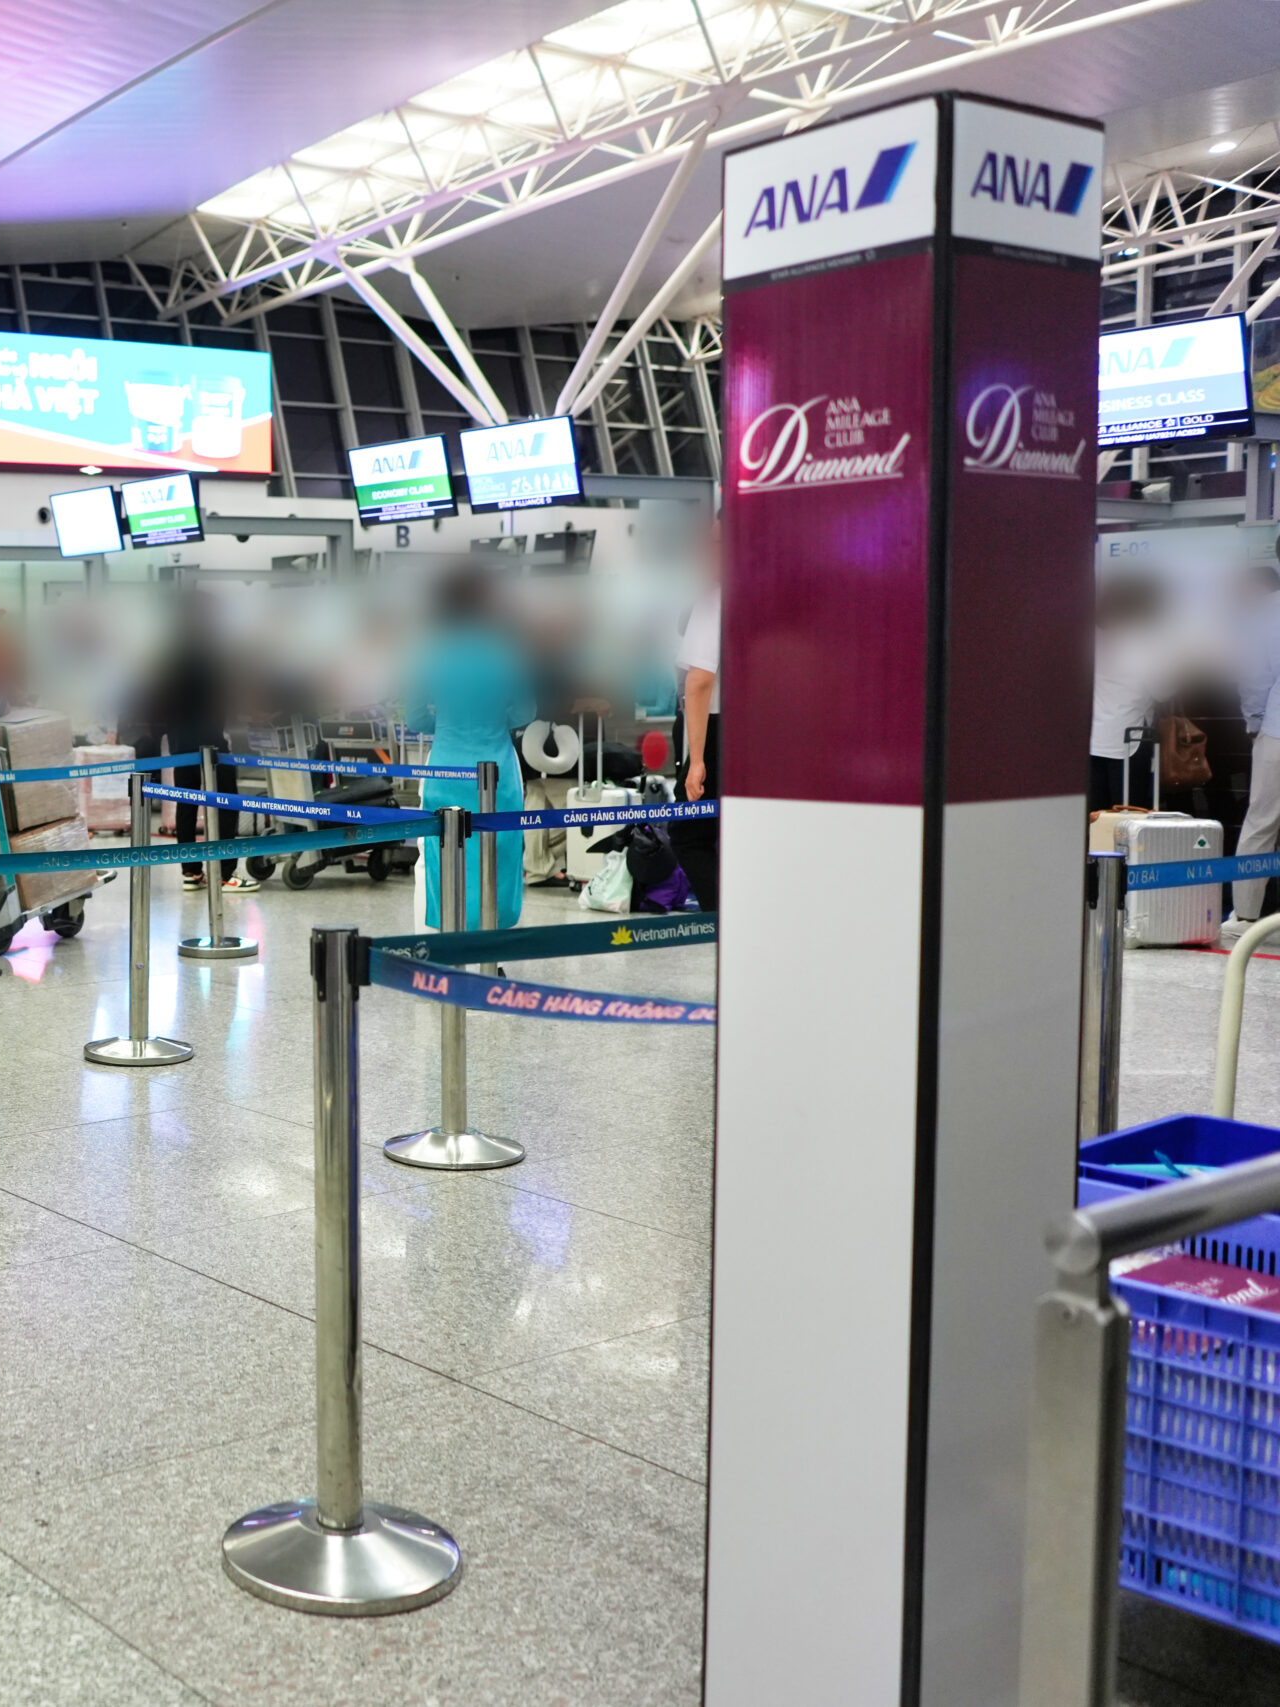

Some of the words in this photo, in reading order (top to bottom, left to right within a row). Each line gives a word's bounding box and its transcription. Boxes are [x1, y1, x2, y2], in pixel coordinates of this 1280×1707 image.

[970, 151, 1050, 212] ANA
[744, 168, 848, 238] ANA
[825, 396, 861, 415] ANA
[1099, 394, 1152, 414] SINESS
[1155, 388, 1206, 406] CLASS
[825, 407, 891, 432] MILEAGE
[963, 383, 1086, 475] Diamond
[1108, 420, 1163, 433] ALLIANCE
[1182, 414, 1214, 425] GOLD
[487, 438, 527, 461] ANA
[738, 394, 911, 490] Diamond
[371, 455, 406, 474] ANA
[371, 487, 408, 501] ECONOMY
[396, 525, 410, 548] B
[434, 770, 477, 779] INTERNATION
[153, 786, 169, 796] KHÔNG
[169, 789, 182, 798] QUỐC
[183, 791, 189, 799] TẾ
[216, 796, 229, 805] N.I.A
[242, 800, 261, 808] NOIBAI
[261, 802, 305, 814] INTERNATIONAL
[305, 807, 331, 816] AIRPORT
[346, 810, 362, 819] N.I.A
[563, 811, 588, 824] CẢNG
[590, 810, 615, 822] HÀNG
[616, 808, 647, 820] KHÔNG
[648, 805, 672, 818] QUỐC
[673, 803, 683, 816] TẾ
[685, 804, 699, 818] NỘI
[701, 803, 714, 814] BÀI
[520, 815, 542, 826] N.I.A
[1237, 858, 1270, 874] NOIBAI
[632, 927, 677, 943] Vietnam
[677, 922, 715, 937] Airlines
[412, 970, 449, 995] N.I.A
[486, 982, 542, 1010] CẢNG
[602, 1000, 686, 1020] KHÔNG
[687, 1008, 716, 1021] QU
